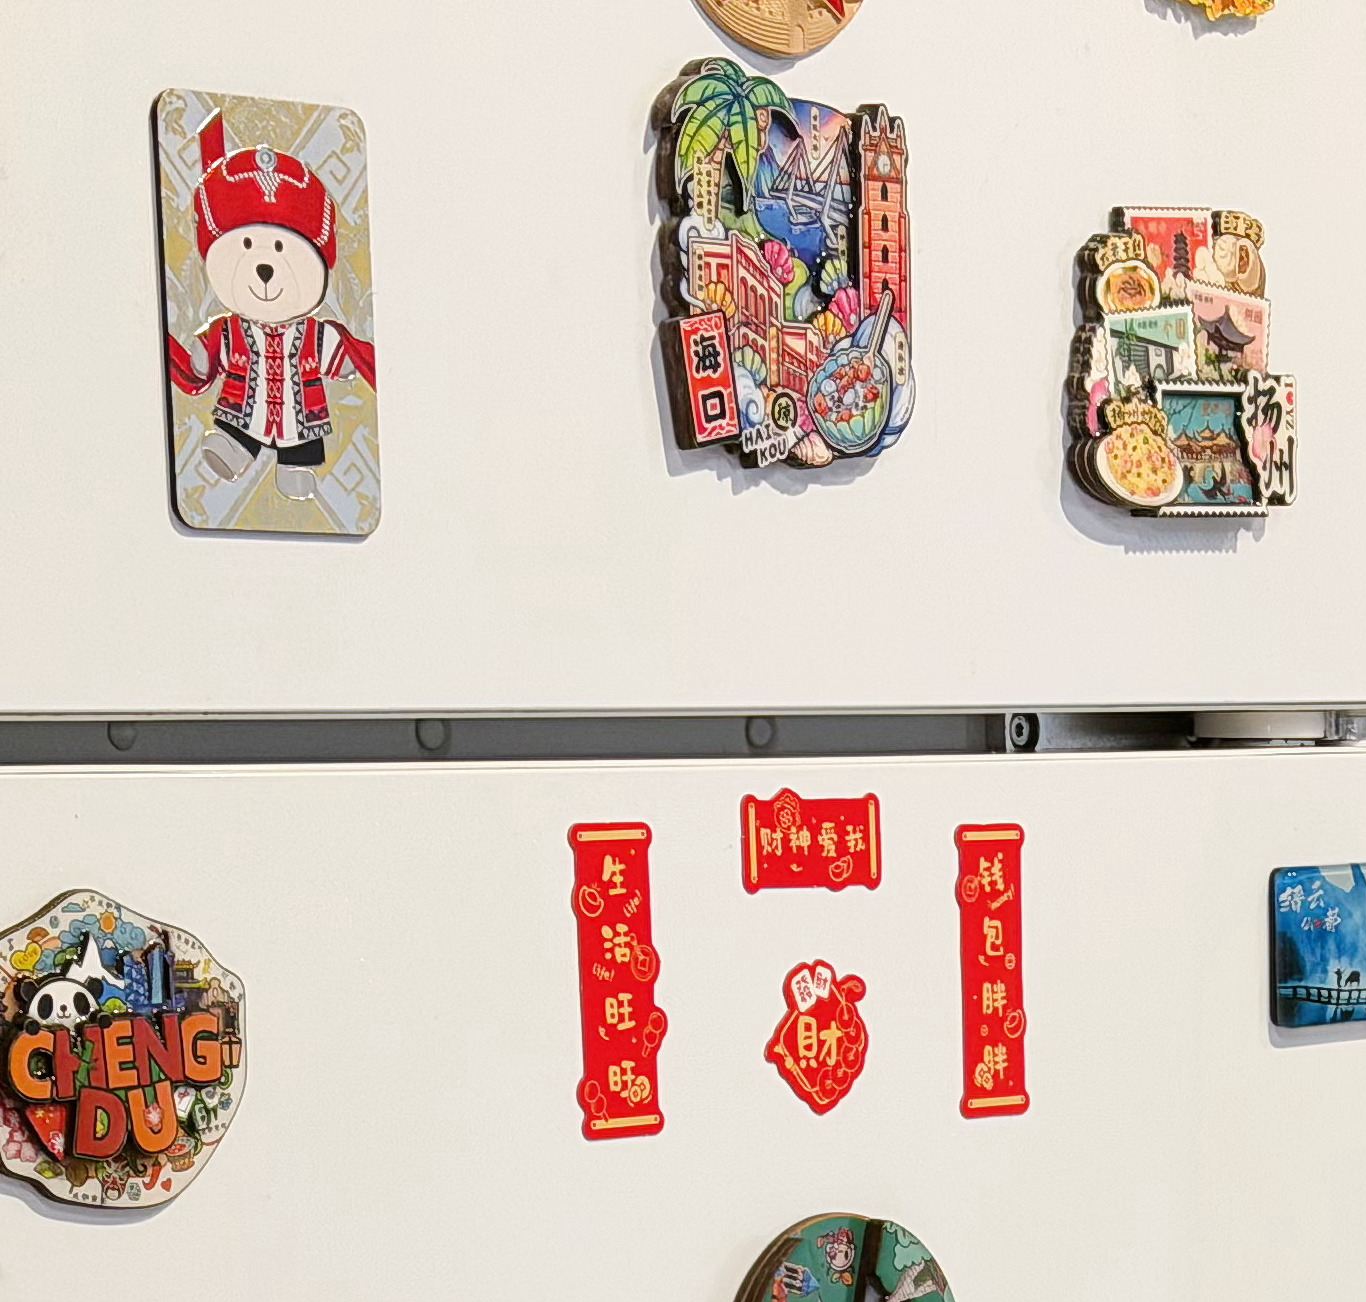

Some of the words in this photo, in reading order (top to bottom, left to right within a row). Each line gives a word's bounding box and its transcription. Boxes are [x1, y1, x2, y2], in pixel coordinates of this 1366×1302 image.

[692, 333, 728, 425] 海口
[744, 423, 771, 450] HAI
[759, 437, 788, 466] KOU
[760, 821, 866, 858] 财神爱我
[601, 854, 637, 1099] 生活旺旺
[980, 851, 1009, 1080] 钱包胖胖
[9, 1012, 223, 1102] CHENG
[797, 1015, 844, 1069] 財
[75, 1080, 179, 1159] DU
